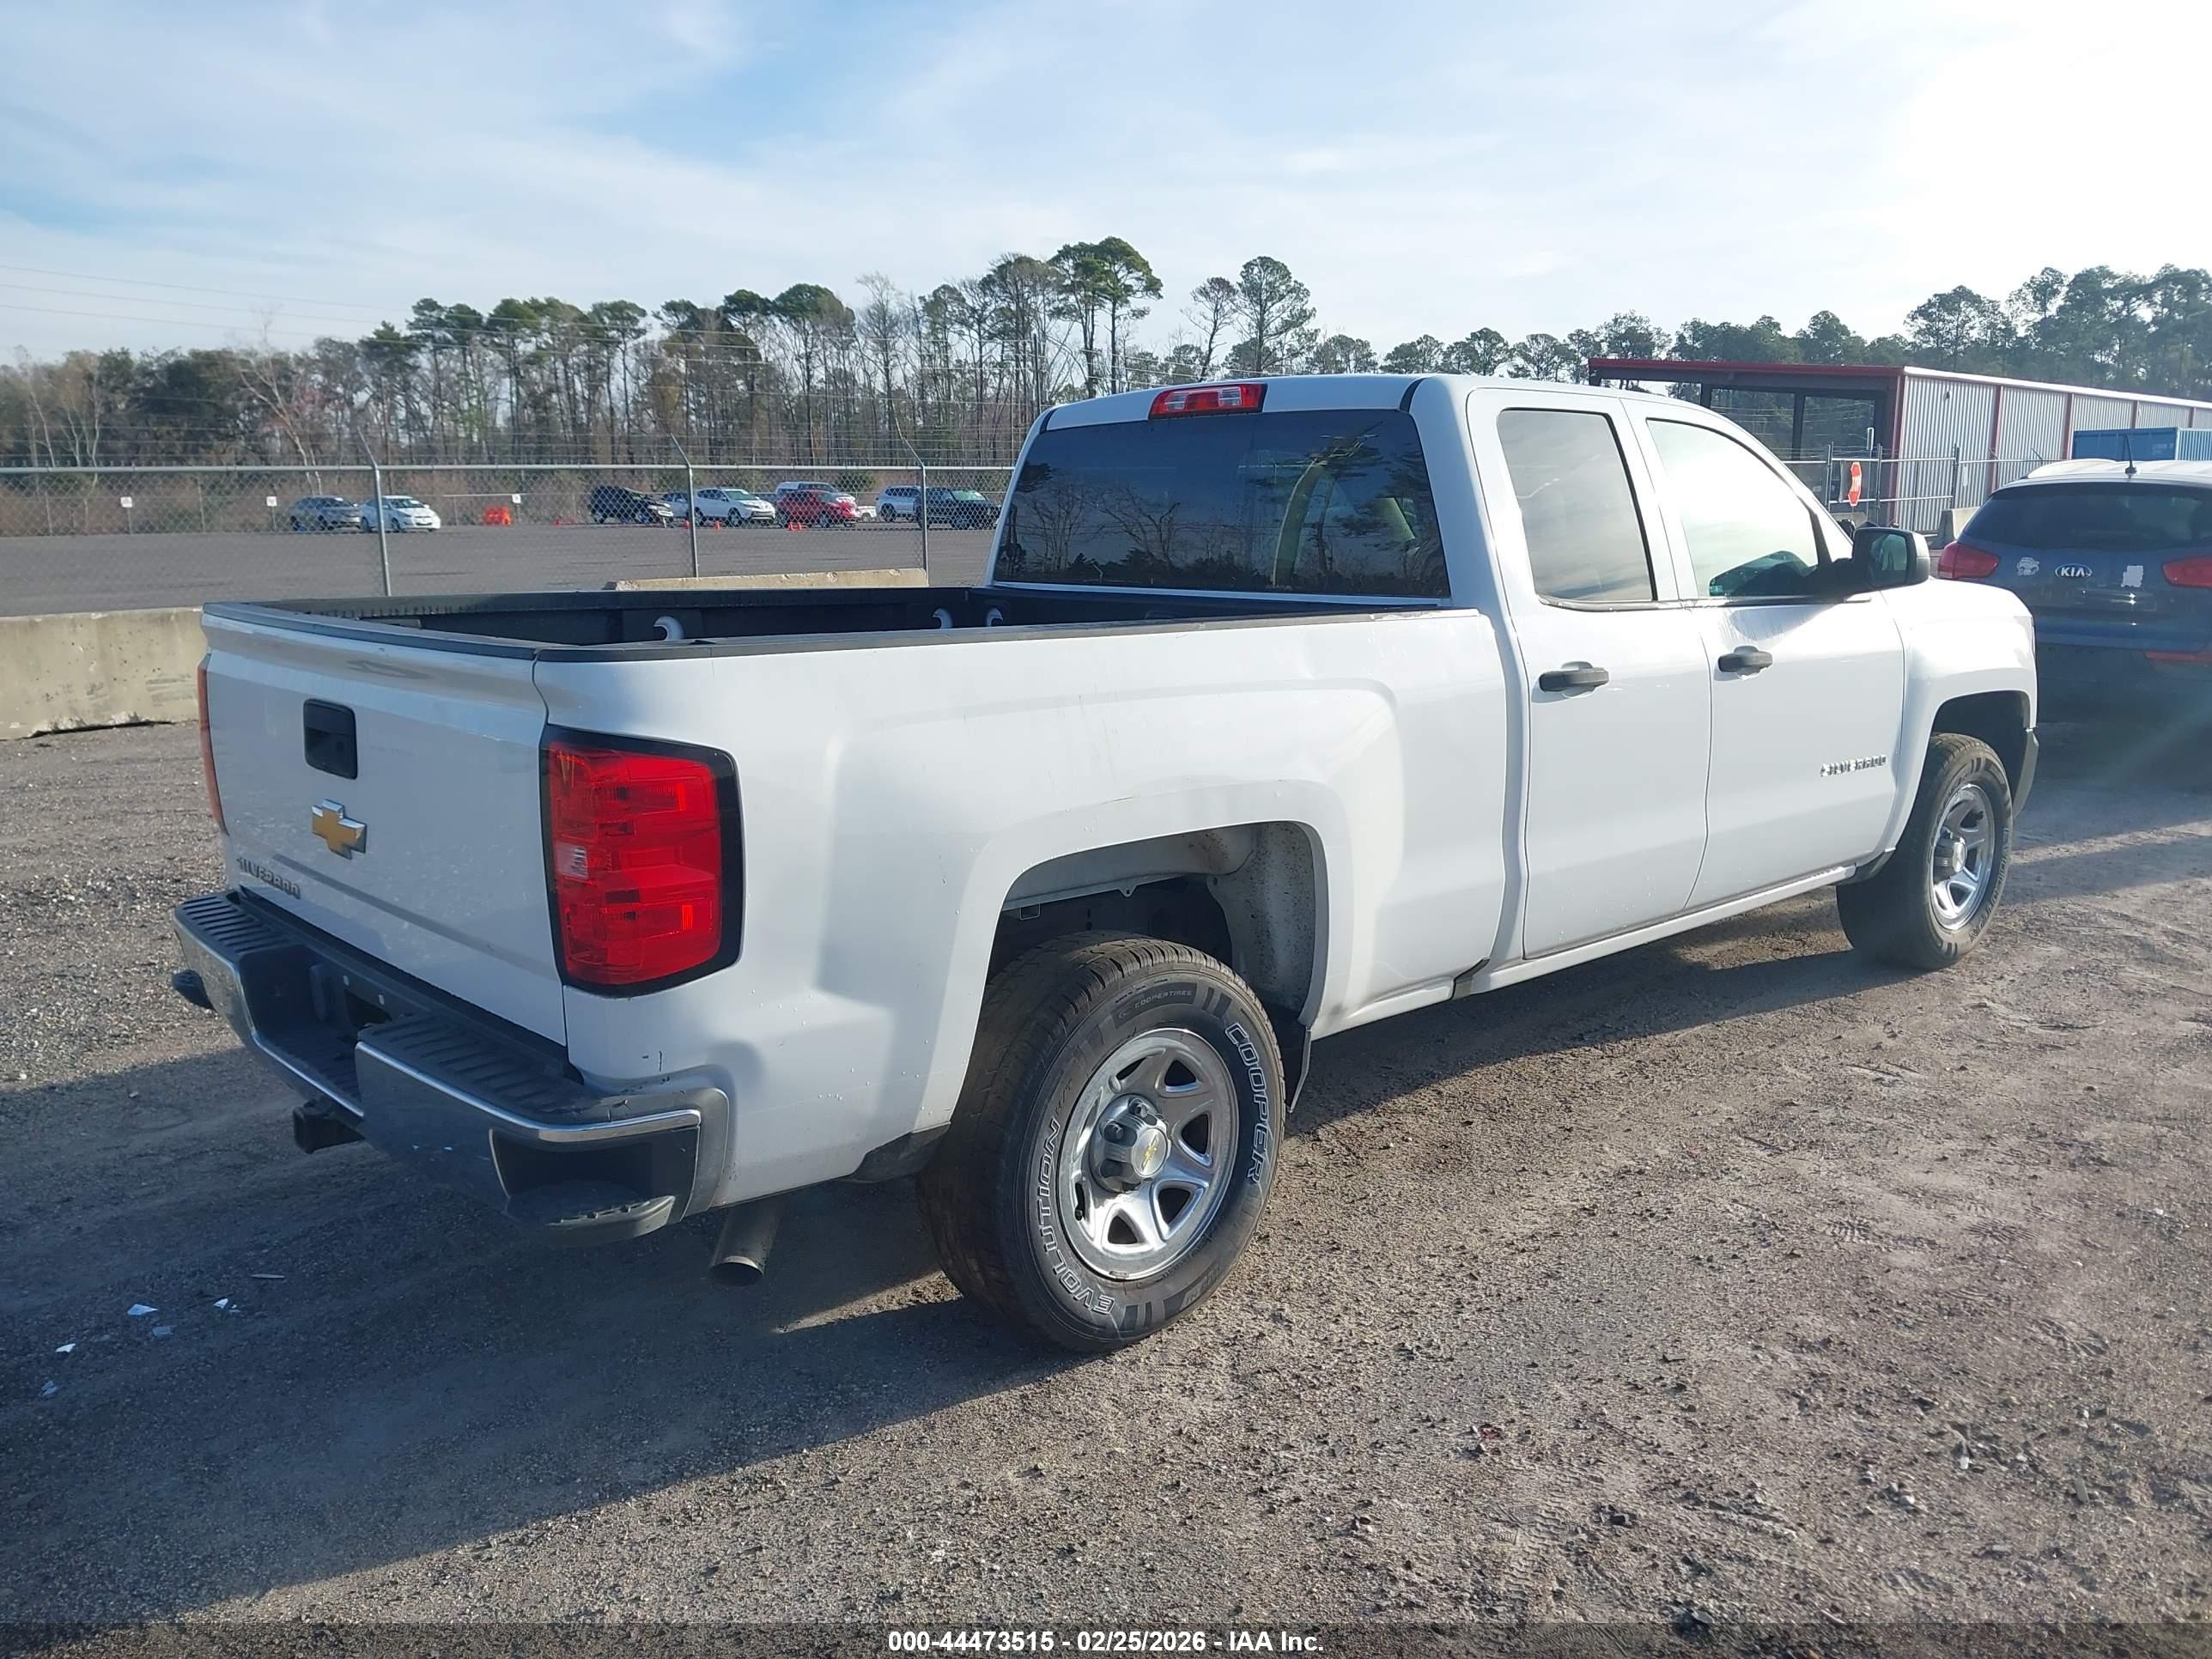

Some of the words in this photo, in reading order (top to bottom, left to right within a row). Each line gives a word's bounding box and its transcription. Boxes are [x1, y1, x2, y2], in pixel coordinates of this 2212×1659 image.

[2061, 567, 2085, 576] KIA
[1820, 755, 1887, 776] SILVERADO
[236, 857, 301, 900] SILVERADO
[1224, 1022, 1269, 1184] COOPER
[1036, 1116, 1115, 1315] EVOLUTION
